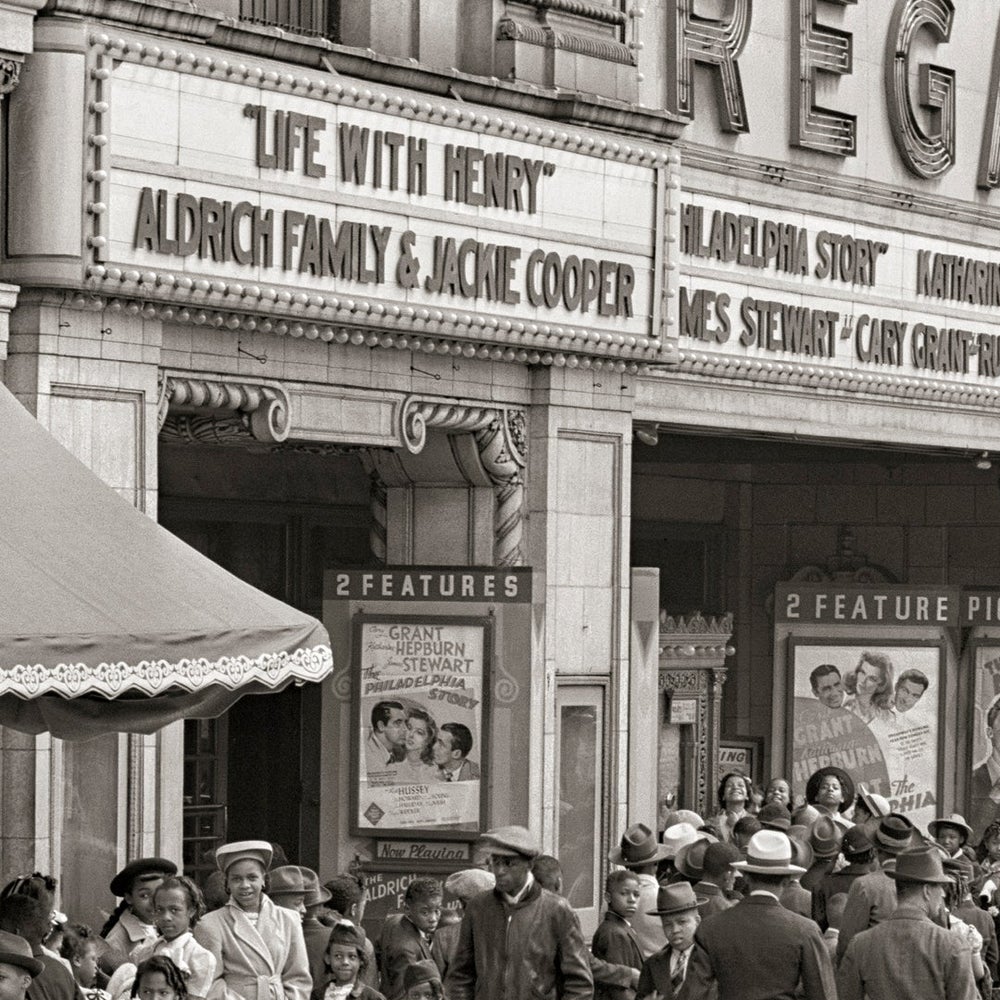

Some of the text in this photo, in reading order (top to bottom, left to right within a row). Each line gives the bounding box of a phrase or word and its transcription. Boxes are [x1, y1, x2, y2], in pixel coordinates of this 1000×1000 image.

[340, 121, 427, 196] WITH
[135, 186, 635, 317] ALDRICH FAMILY & JACKIE COOPER
[680, 203, 809, 277] HILADELPHIA
[679, 286, 731, 344] MES
[740, 297, 839, 358] STEWART
[856, 313, 907, 367] CARY
[912, 323, 972, 375] GRANT
[336, 574, 518, 597] 2 FEATURES
[787, 593, 800, 618] 2
[815, 594, 948, 621] FEATURE
[389, 625, 444, 641] GRANT
[395, 640, 465, 658] HEPBURN
[403, 657, 474, 674] STEWART
[364, 674, 466, 695] PHILADELPHIA
[428, 688, 480, 710] STORY
[795, 714, 853, 745] GRANT
[793, 745, 883, 782] HEPBURN
[892, 774, 916, 797] The
[381, 842, 464, 860] Now Playing
[364, 873, 383, 887] THE
[364, 873, 418, 902] ALDRICH
